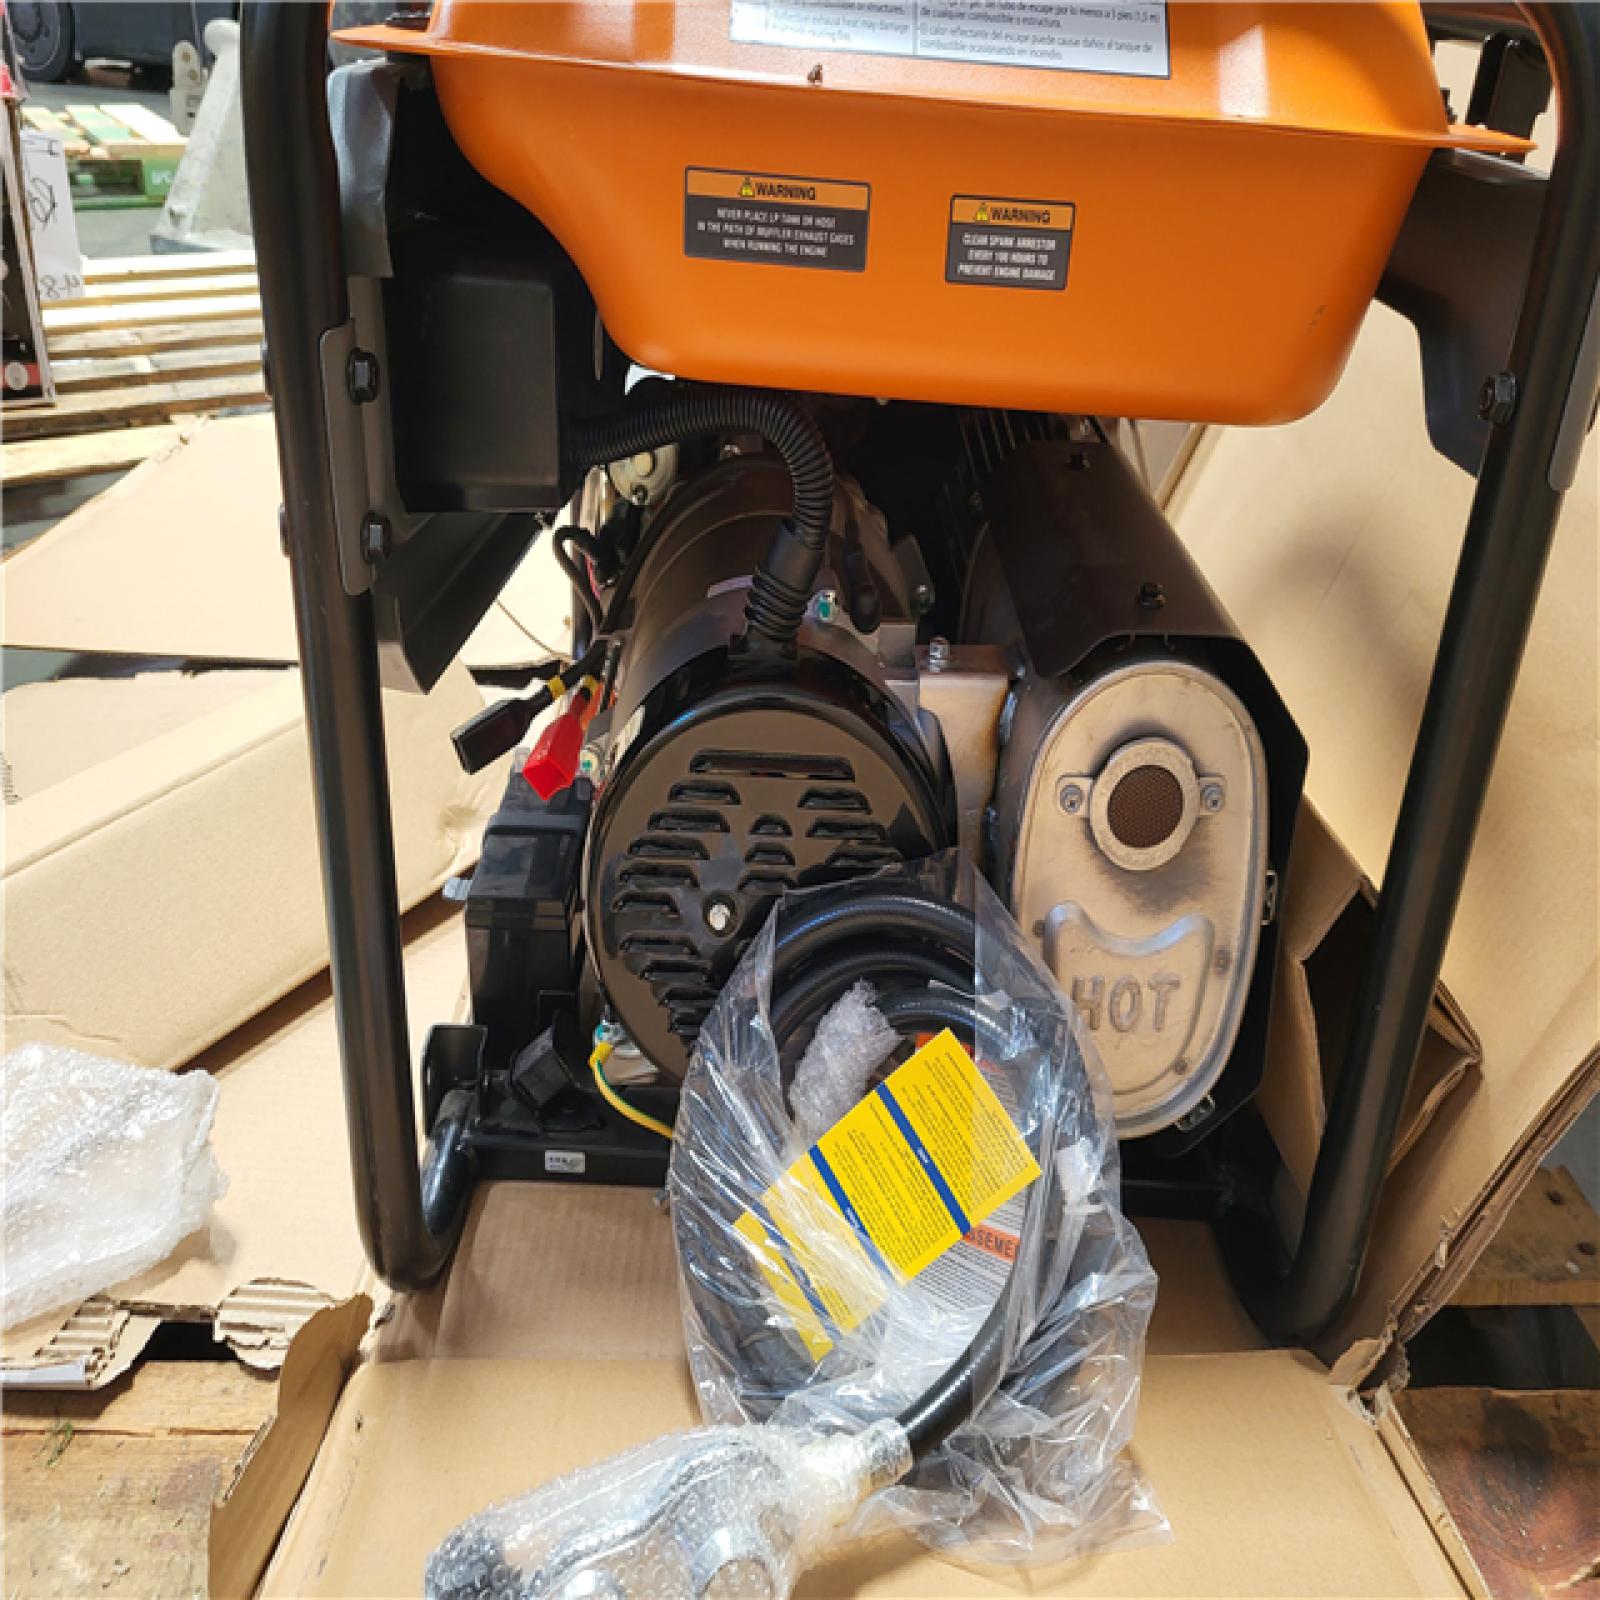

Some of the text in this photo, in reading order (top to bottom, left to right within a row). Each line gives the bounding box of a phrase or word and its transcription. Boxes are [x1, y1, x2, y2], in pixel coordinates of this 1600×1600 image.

[755, 182, 816, 201] WARNING
[717, 207, 741, 220] NEVER
[745, 210, 768, 223] PLACE
[991, 206, 1051, 225] WARNING
[794, 228, 829, 242] EXHAUST
[747, 239, 783, 254] RUNNING
[800, 244, 828, 257] ENGINE
[1072, 971, 1181, 1033] HOT
